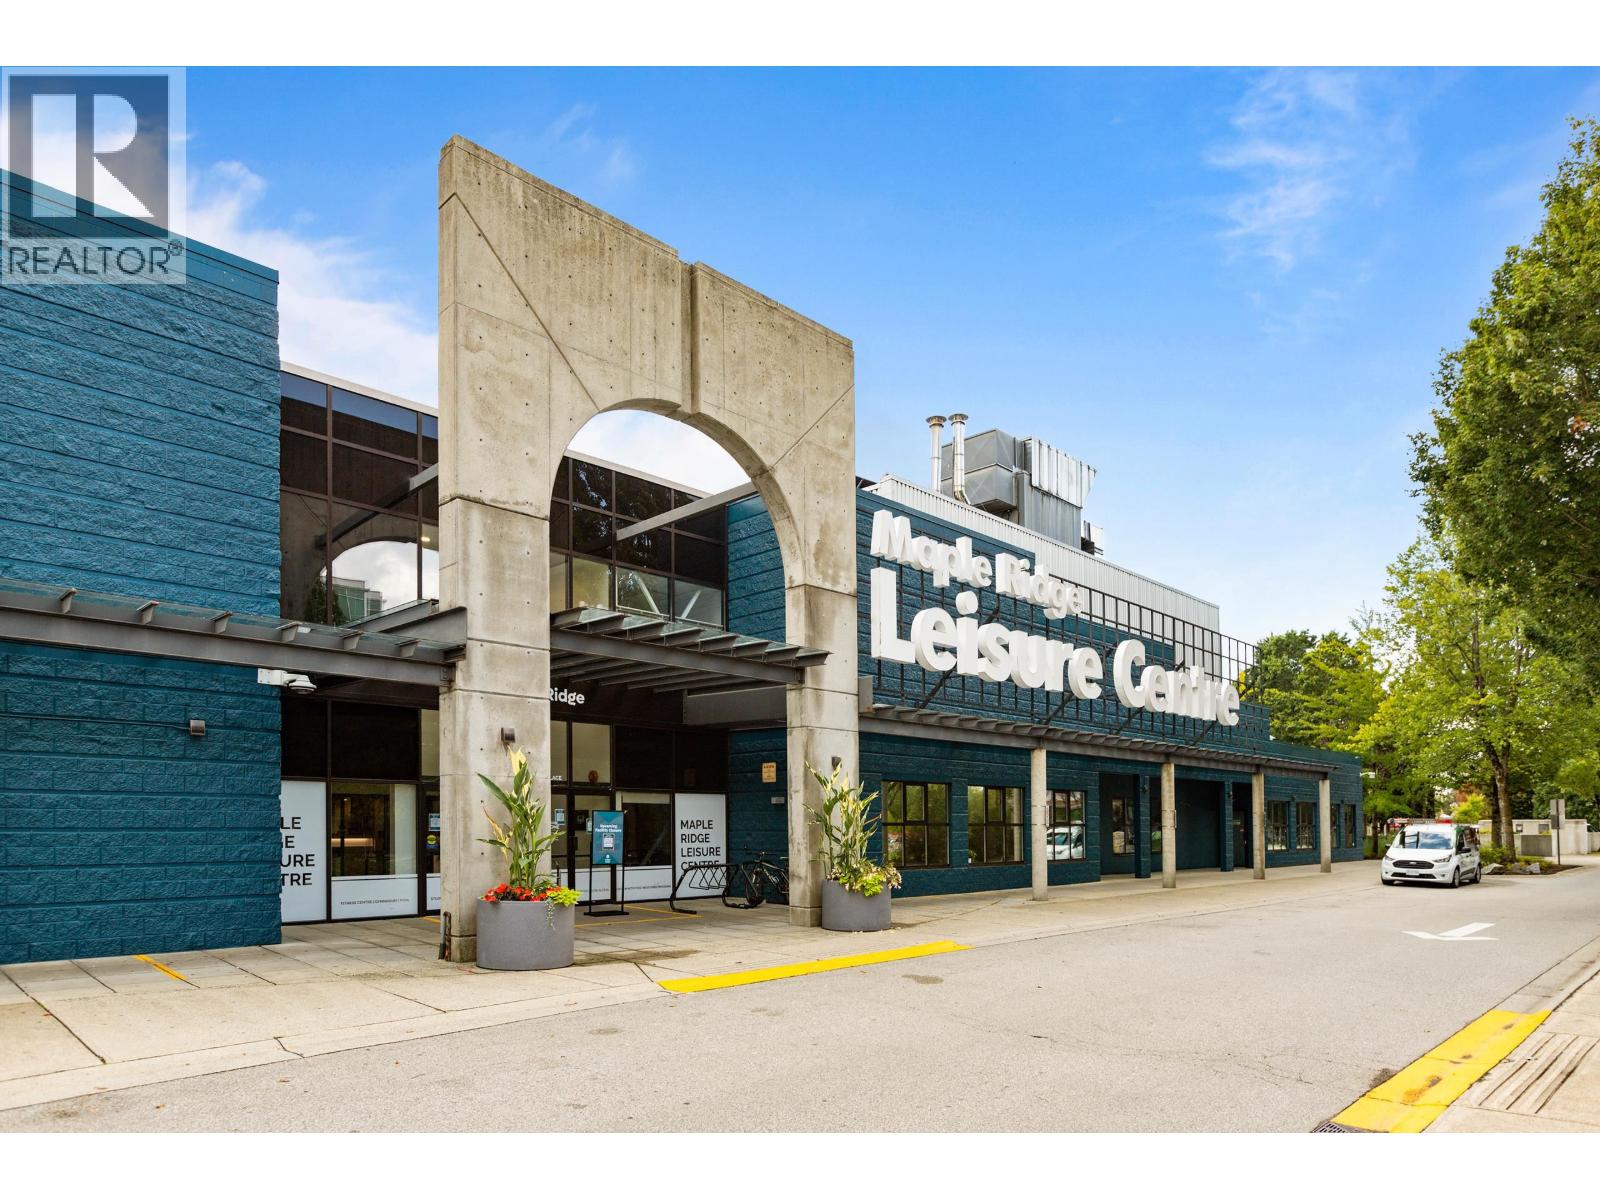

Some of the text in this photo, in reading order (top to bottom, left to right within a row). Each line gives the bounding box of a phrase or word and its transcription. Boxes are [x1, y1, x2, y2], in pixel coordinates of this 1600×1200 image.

[870, 509, 1083, 619] Maple Ridge
[870, 567, 1240, 726] Leisure Centre
[680, 819, 714, 830] MAPLE
[680, 833, 711, 844] RIDGE
[680, 846, 721, 858] LEISURE
